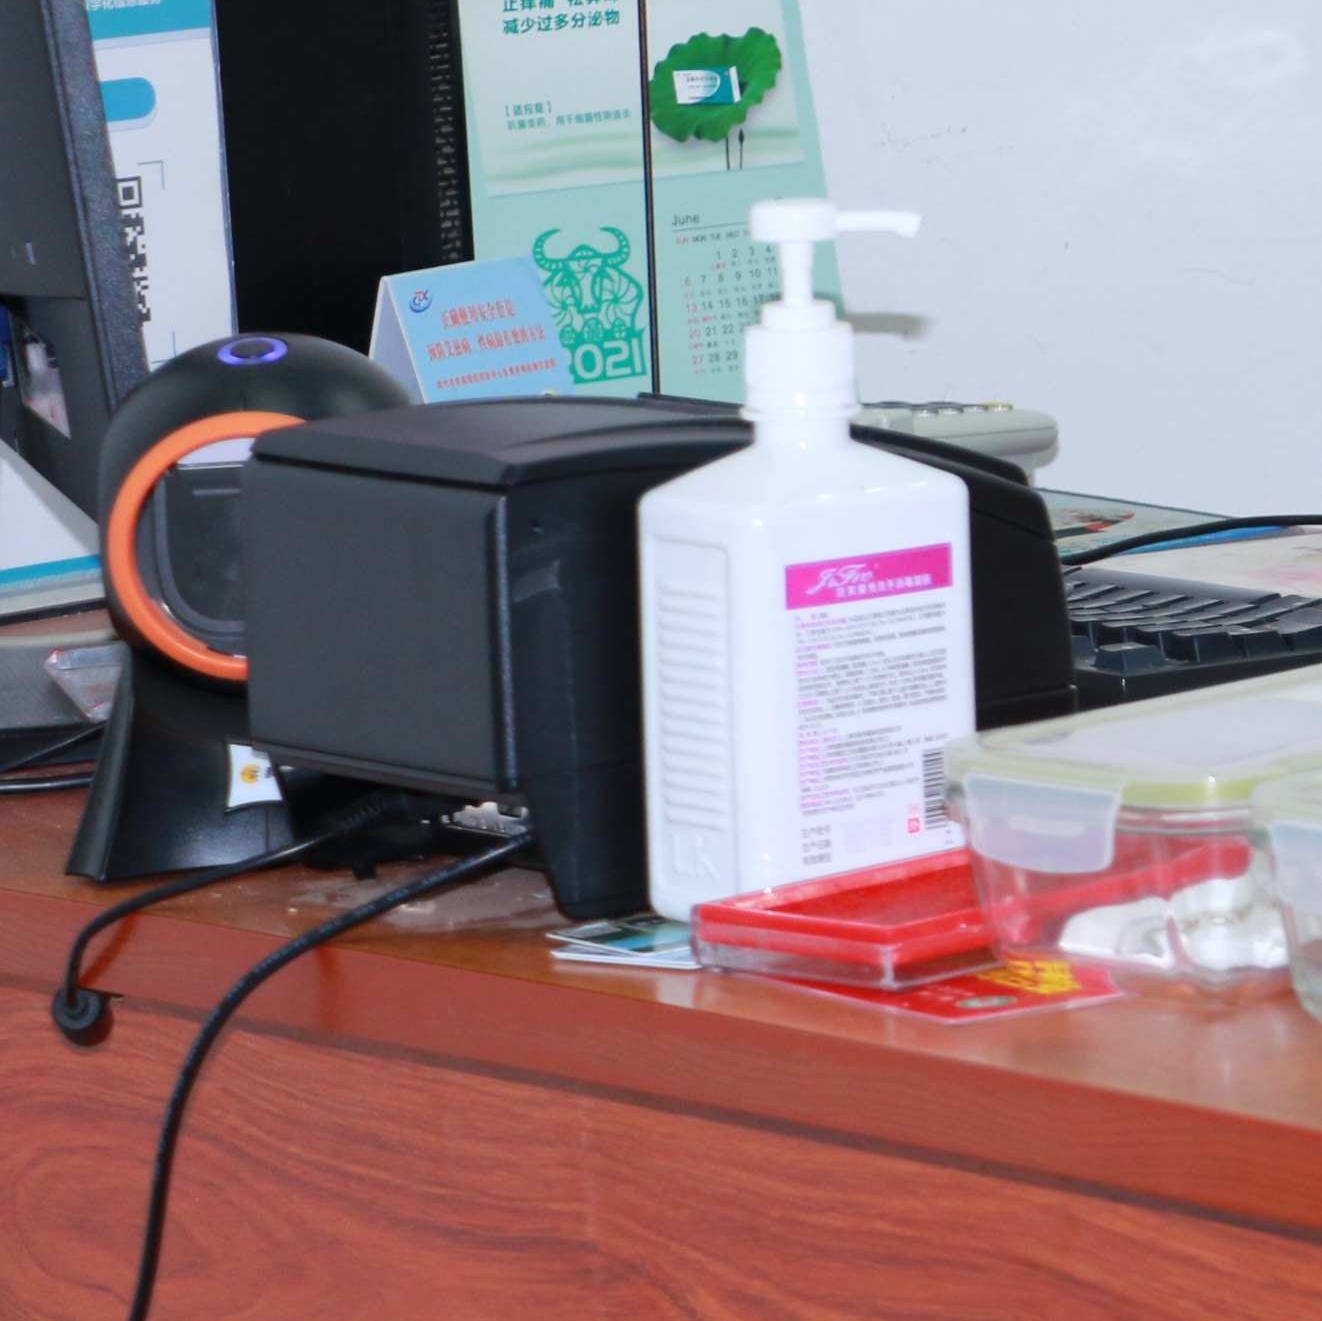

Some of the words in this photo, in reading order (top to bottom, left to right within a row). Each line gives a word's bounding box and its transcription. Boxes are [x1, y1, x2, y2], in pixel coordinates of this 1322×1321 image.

[502, 10, 621, 35] 减少过多分泌物
[671, 213, 700, 227] June
[732, 248, 738, 258] 2
[701, 274, 707, 284] 7
[749, 268, 761, 278] 10
[705, 326, 717, 337] 21
[722, 324, 734, 335] 22
[564, 338, 643, 380] 021
